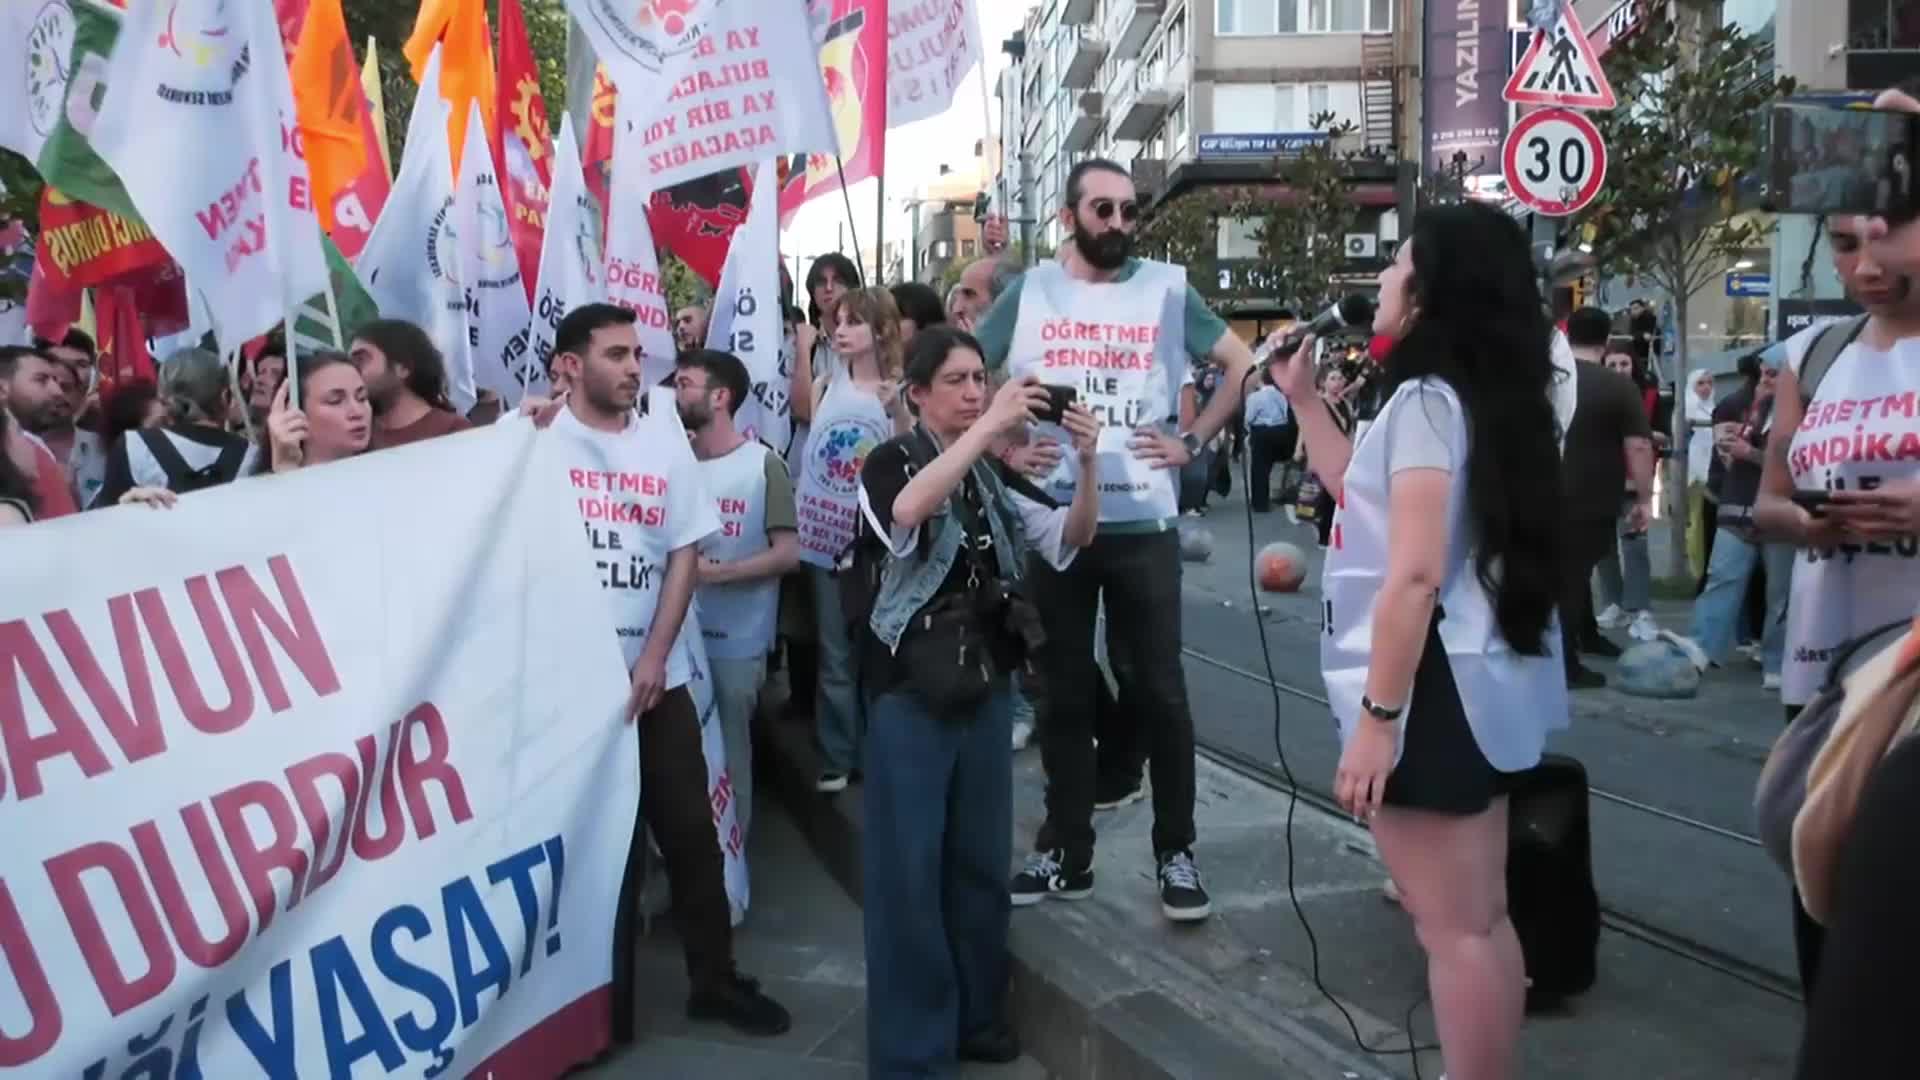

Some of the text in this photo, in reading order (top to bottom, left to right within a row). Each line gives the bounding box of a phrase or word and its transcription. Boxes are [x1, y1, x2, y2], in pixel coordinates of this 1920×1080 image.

[1525, 136, 1585, 184] 30
[1044, 345, 1153, 370] SENDİKAS
[1085, 370, 1118, 396] İLE
[1800, 391, 1920, 432] ĞRETM
[1791, 424, 1920, 477] SENDİKA
[569, 468, 668, 497] RETMEN
[579, 495, 665, 527] DİKASI
[0, 554, 342, 801] AVUN
[42, 702, 473, 1018] DURDUR
[225, 833, 565, 1080] YAŞAT!
